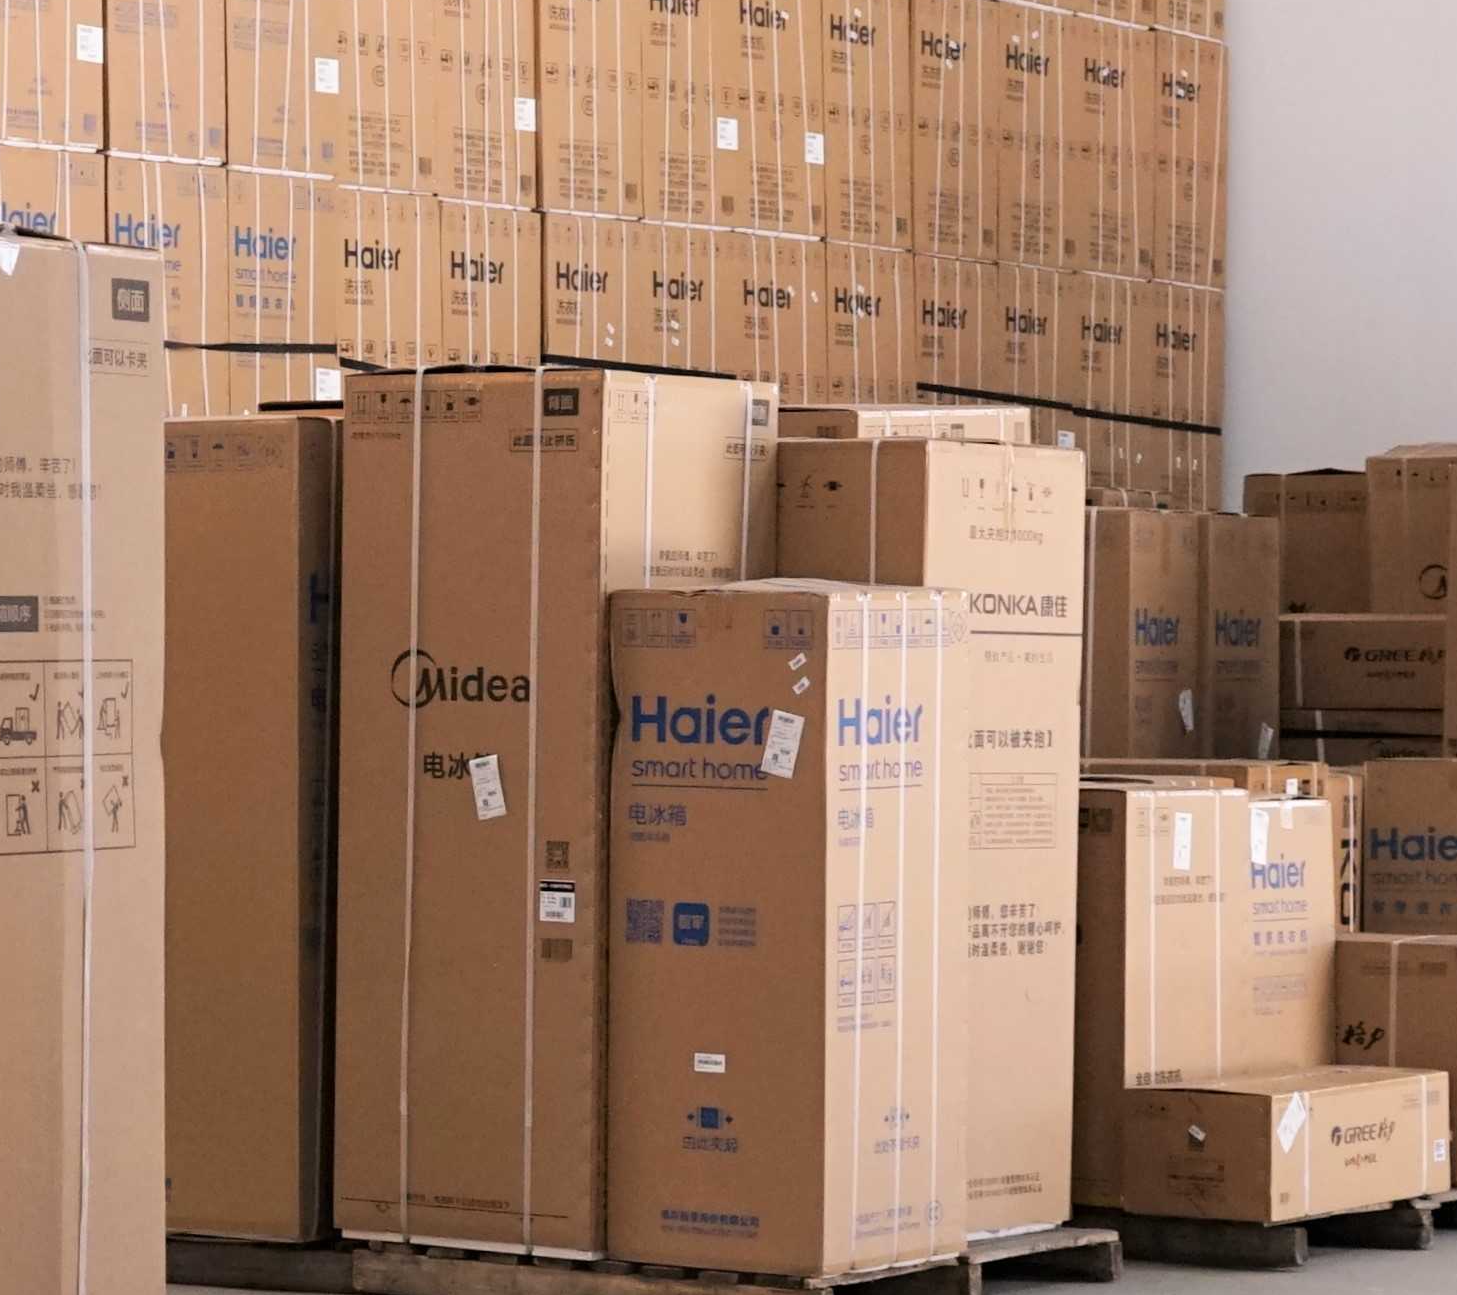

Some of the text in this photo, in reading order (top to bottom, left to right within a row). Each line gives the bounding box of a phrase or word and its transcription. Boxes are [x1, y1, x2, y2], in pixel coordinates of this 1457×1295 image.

[1006, 44, 1049, 77] Haier
[1084, 58, 1125, 89] Haier
[115, 213, 181, 250] Haier
[235, 226, 296, 260] Haier
[344, 239, 400, 271] Haier
[450, 251, 504, 285] Haier
[556, 261, 607, 294] Haier
[652, 270, 703, 302] Haier
[835, 287, 880, 318] Haier
[922, 299, 967, 330] Haier
[1005, 306, 1047, 336] Haier
[1082, 315, 1121, 345] Haier
[1156, 324, 1197, 352] Haier
[87, 347, 148, 369] 面可以卡夹
[1135, 607, 1179, 647] Haier
[1216, 607, 1261, 647] Haier
[398, 654, 530, 707] Midea
[630, 695, 770, 747] Haier
[839, 694, 922, 747] Haier
[968, 729, 1053, 749] 面可以被夹抱】
[631, 757, 767, 780] smart home
[628, 803, 689, 828] 电冰箱
[1251, 854, 1306, 889] Haier
